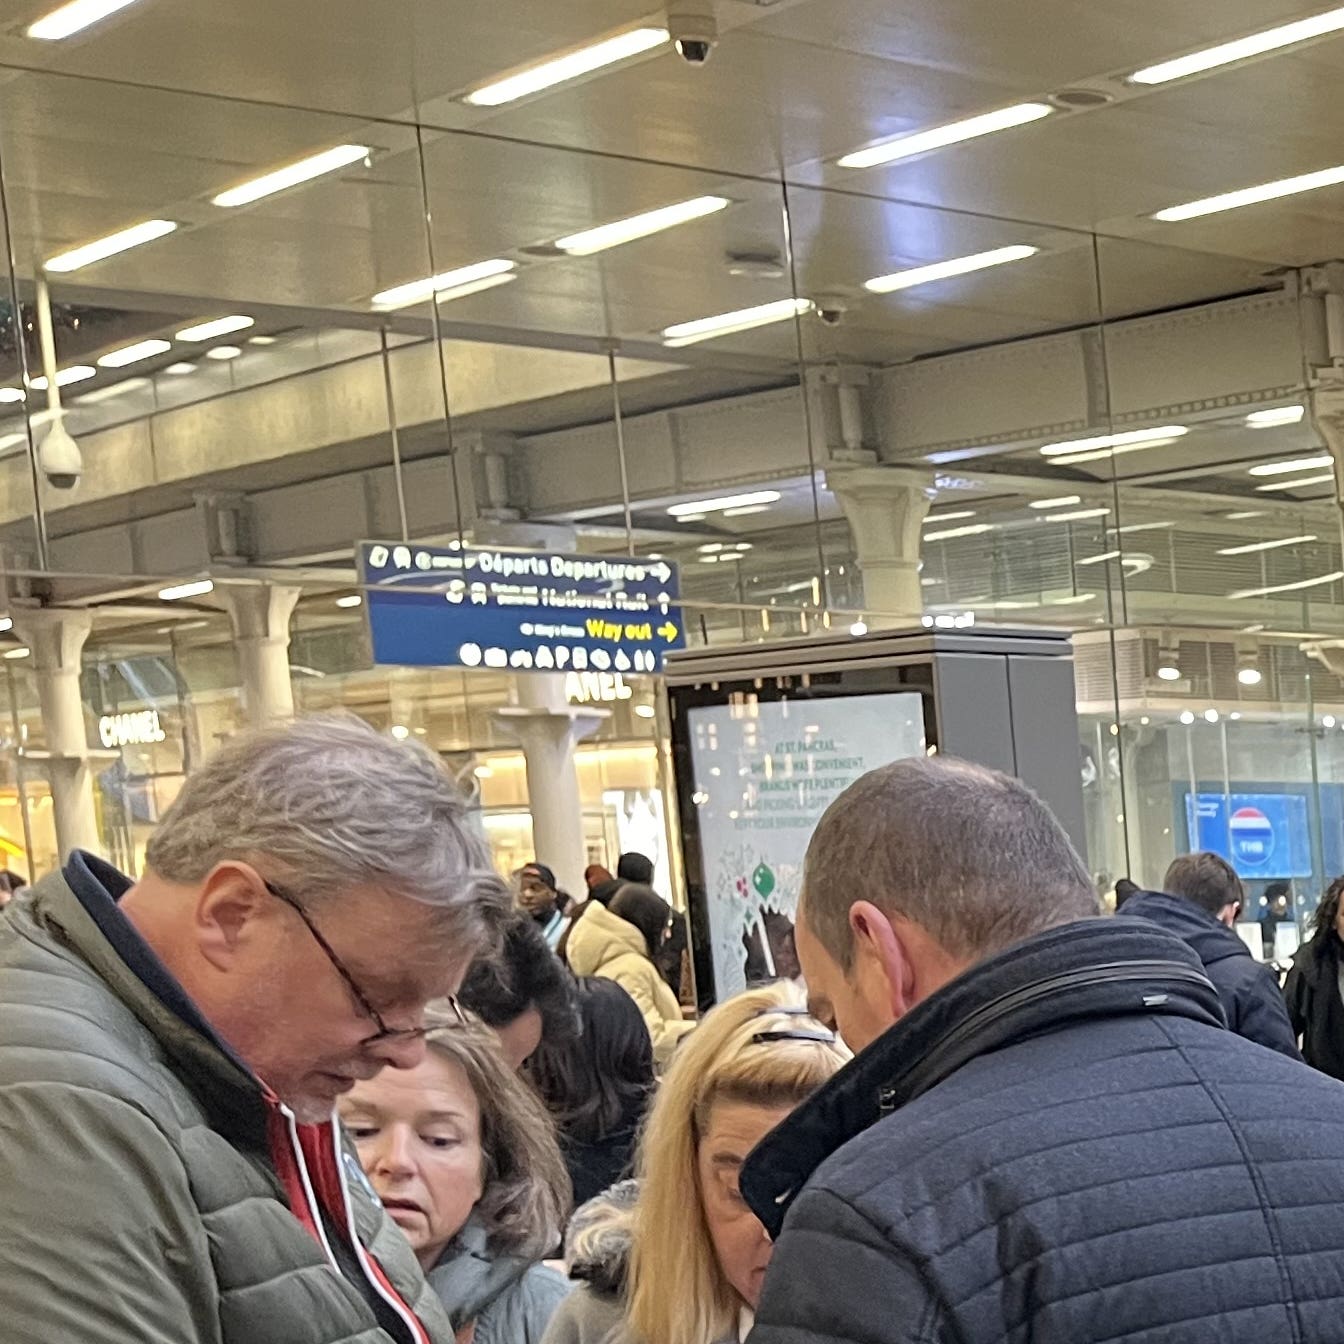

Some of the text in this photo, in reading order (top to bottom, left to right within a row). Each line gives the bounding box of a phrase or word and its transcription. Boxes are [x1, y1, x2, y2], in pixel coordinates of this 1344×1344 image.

[478, 552, 548, 576] Départs
[551, 556, 646, 582] Departures
[586, 618, 652, 642] Way out
[565, 671, 632, 702] ANEL
[99, 710, 165, 748] CHANEL
